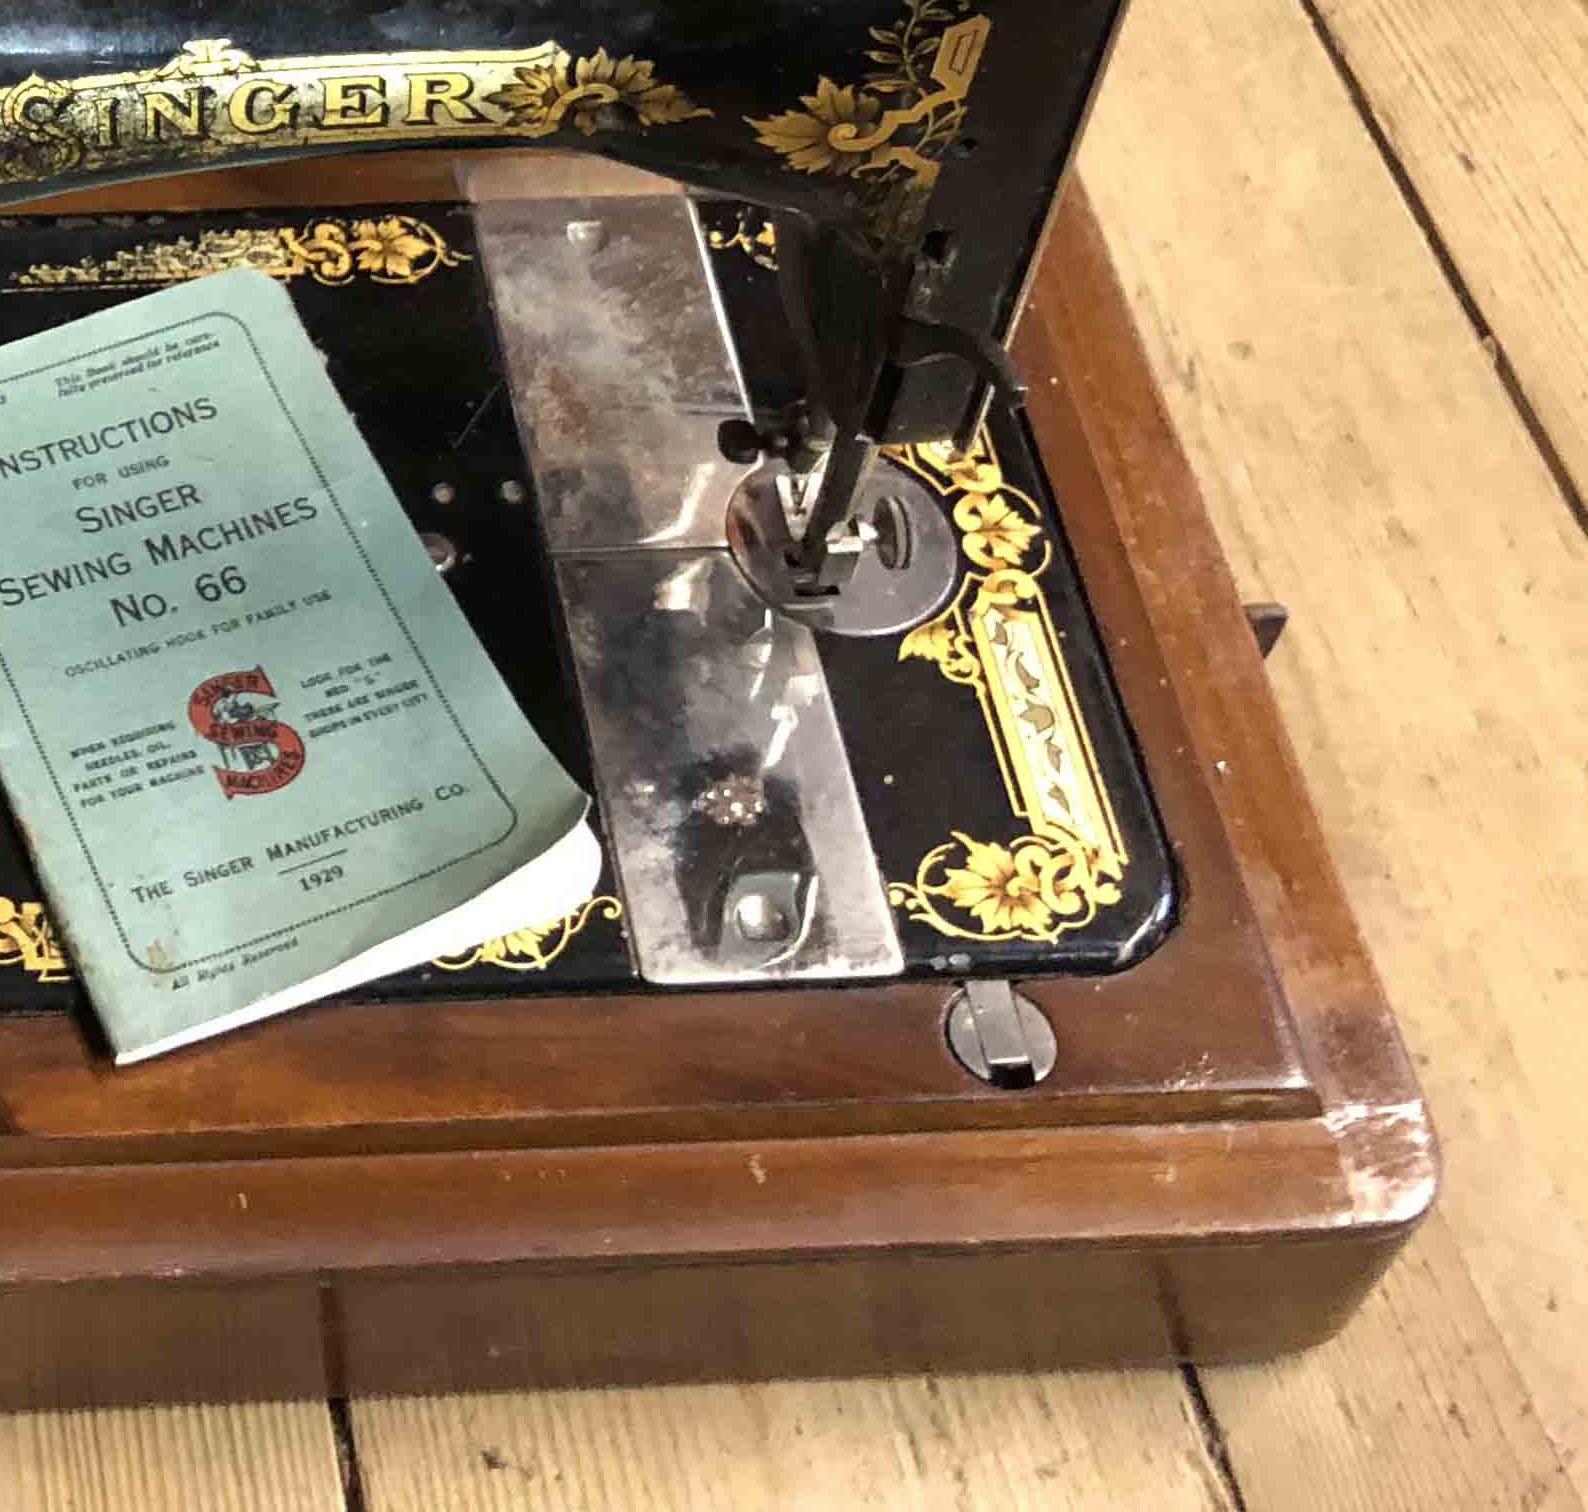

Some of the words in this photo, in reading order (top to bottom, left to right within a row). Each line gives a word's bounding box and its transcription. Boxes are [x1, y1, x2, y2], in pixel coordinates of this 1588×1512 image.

[4, 72, 492, 168] SINGER
[73, 472, 108, 490] FOR
[118, 455, 170, 480] USING
[76, 483, 202, 534] SINGER
[144, 497, 317, 566] MACHINES
[195, 565, 247, 603] 66
[65, 642, 161, 678] OSCILLATING
[166, 630, 207, 649] HOOK
[212, 619, 241, 636] FOR
[245, 602, 297, 626] FAMILY
[301, 589, 333, 606] USE
[300, 671, 333, 689] LOOK
[338, 662, 365, 679] FOR
[71, 741, 106, 760] WHEN
[111, 721, 177, 746] REQUIRING
[72, 774, 111, 793] PARTS
[121, 766, 139, 780] OR
[146, 749, 198, 771] REPAIRS
[81, 794, 104, 809] FOR
[112, 784, 144, 801] YOUR
[149, 765, 205, 788] MACHINE
[131, 880, 173, 904] THE
[183, 856, 255, 889] SINGER
[265, 798, 425, 862] MANUFACTURING
[299, 865, 345, 891] 1929
